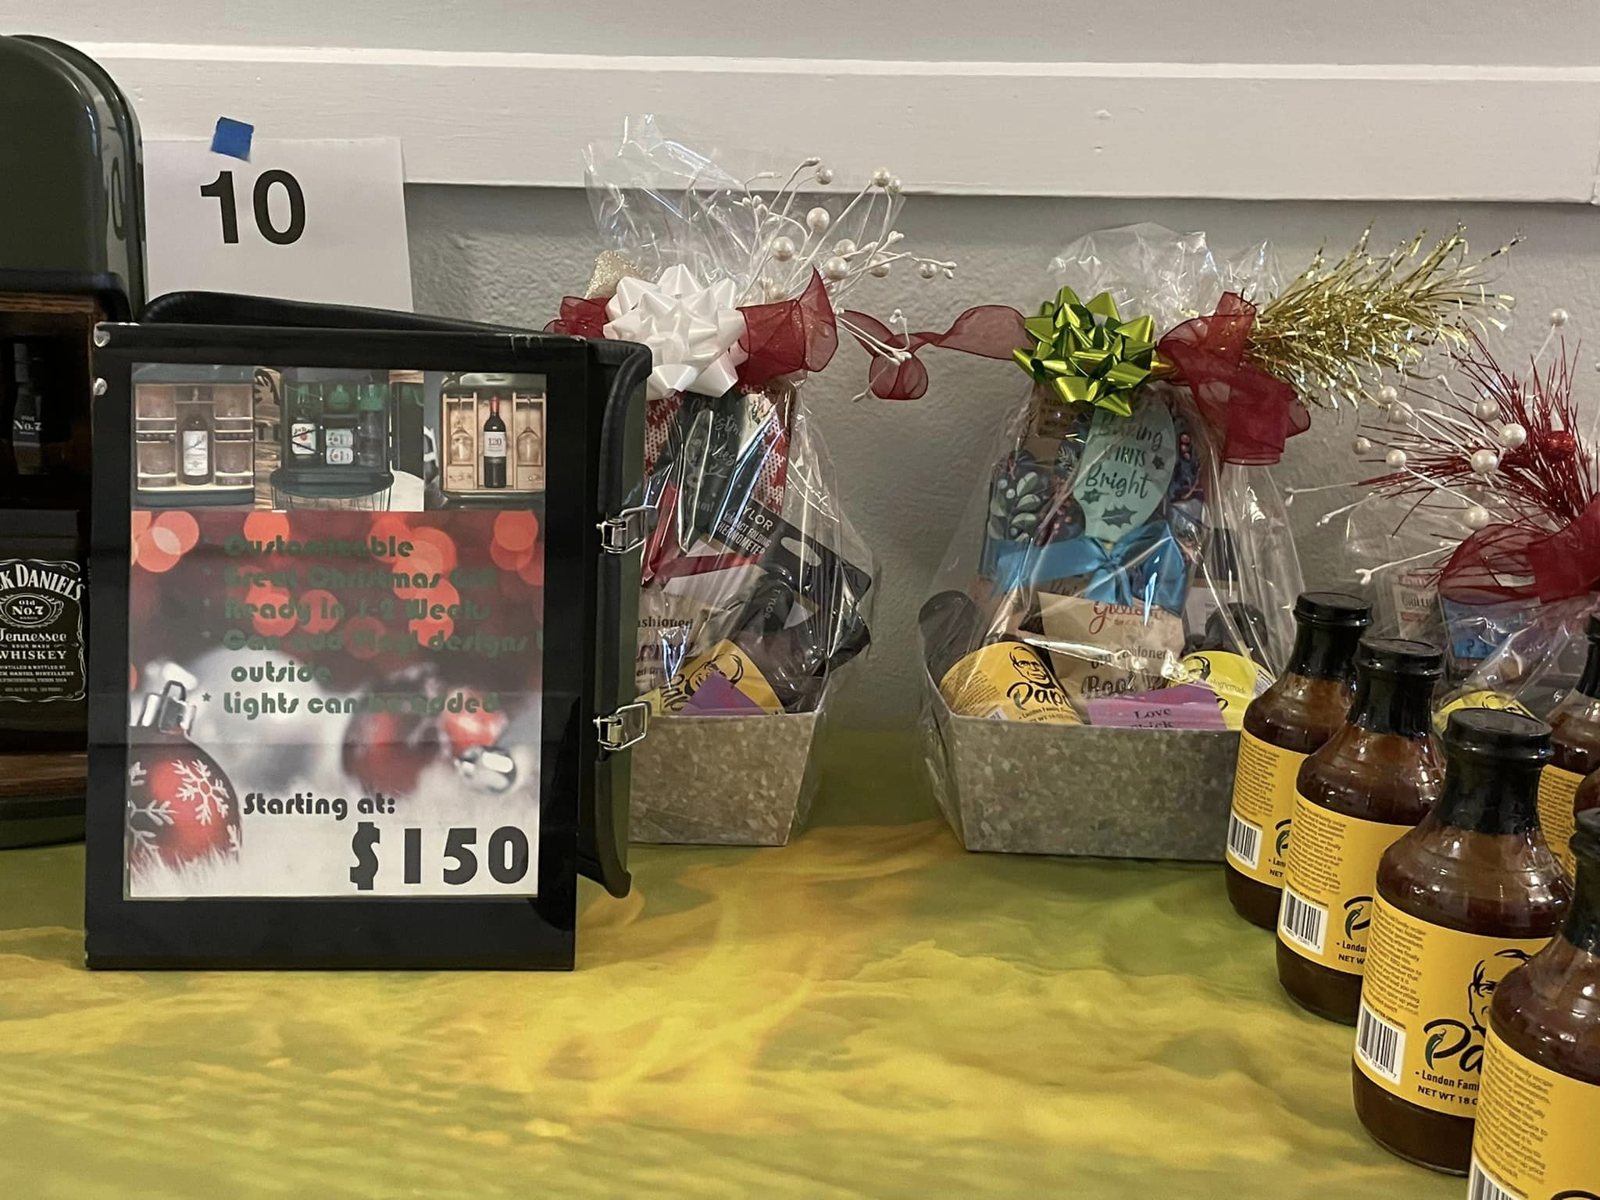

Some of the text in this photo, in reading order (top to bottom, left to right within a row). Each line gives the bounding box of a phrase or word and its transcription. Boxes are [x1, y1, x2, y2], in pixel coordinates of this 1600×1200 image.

[200, 169, 306, 245] 10
[1085, 463, 1152, 499] Bright
[15, 563, 86, 600] DANIEL'S
[12, 606, 44, 616] No.7
[231, 661, 332, 683] outside
[223, 691, 300, 720] Lights
[307, 697, 360, 714] can
[1133, 708, 1172, 720] Love
[243, 793, 396, 820] Starting at:
[350, 822, 529, 890] $150
[1338, 954, 1365, 965] NET W
[1421, 1070, 1480, 1092] London Fami
[1418, 1085, 1437, 1097] NET
[1439, 1090, 1455, 1102] WT
[1458, 1096, 1469, 1105] 18
